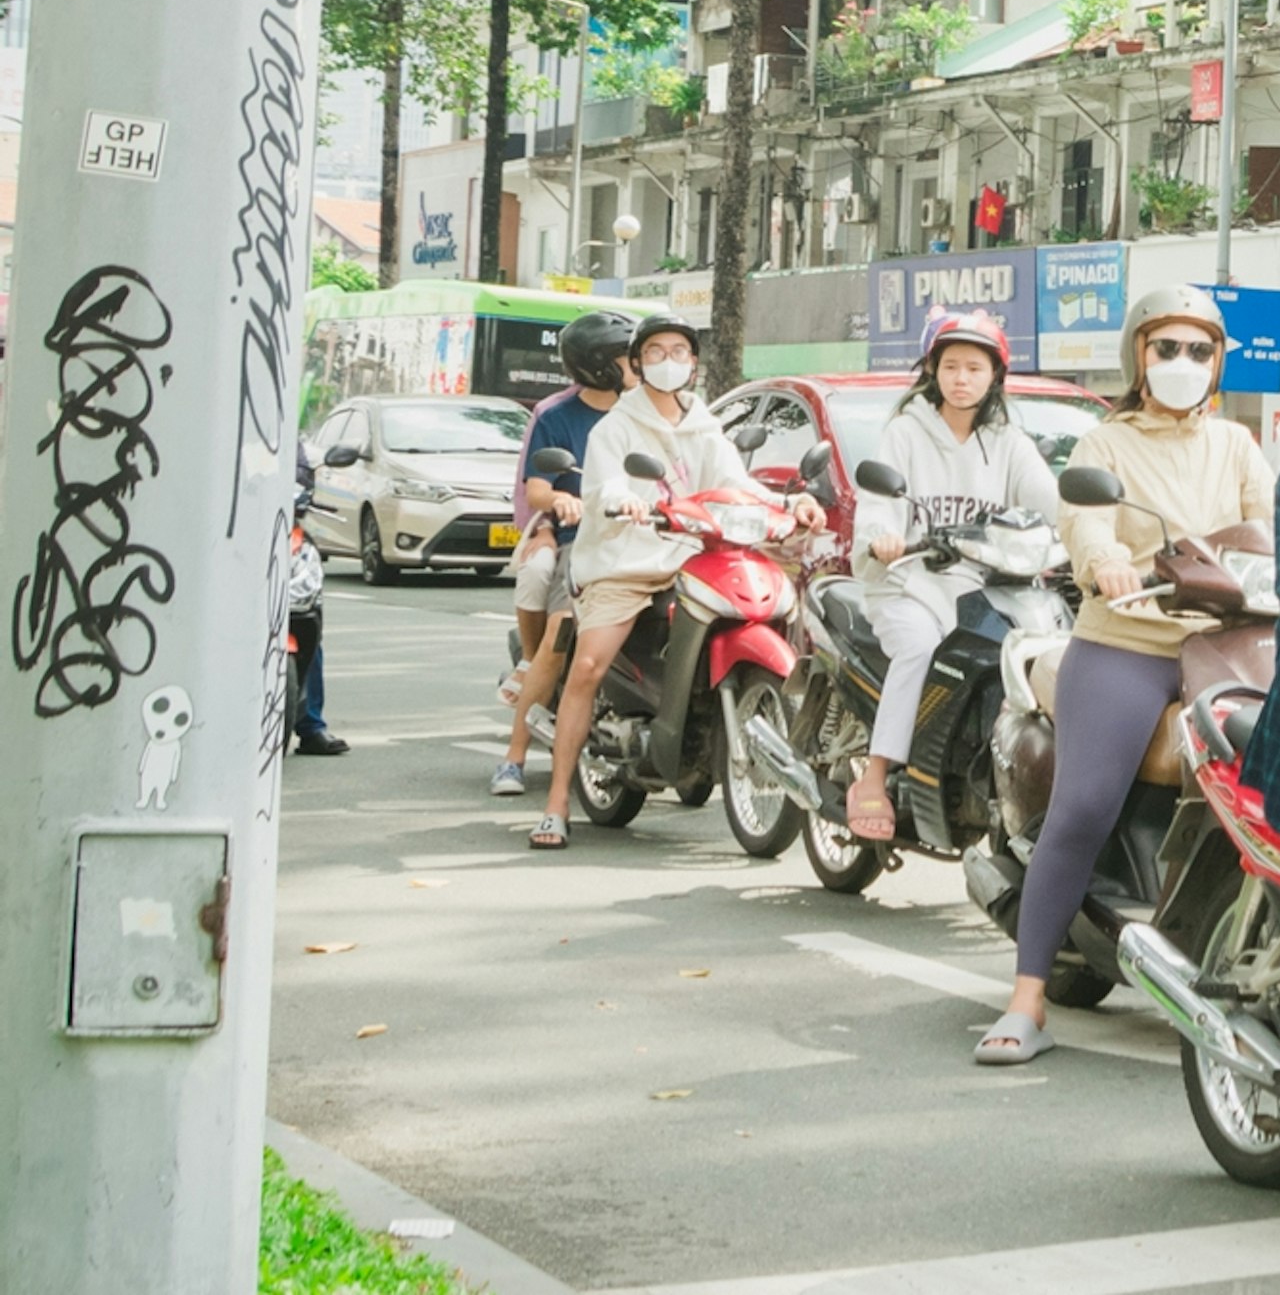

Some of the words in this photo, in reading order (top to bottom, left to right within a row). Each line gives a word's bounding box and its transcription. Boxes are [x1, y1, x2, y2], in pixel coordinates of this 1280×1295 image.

[105, 120, 144, 143] GP
[914, 265, 1013, 307] PINACO
[1059, 263, 1119, 287] PINACO
